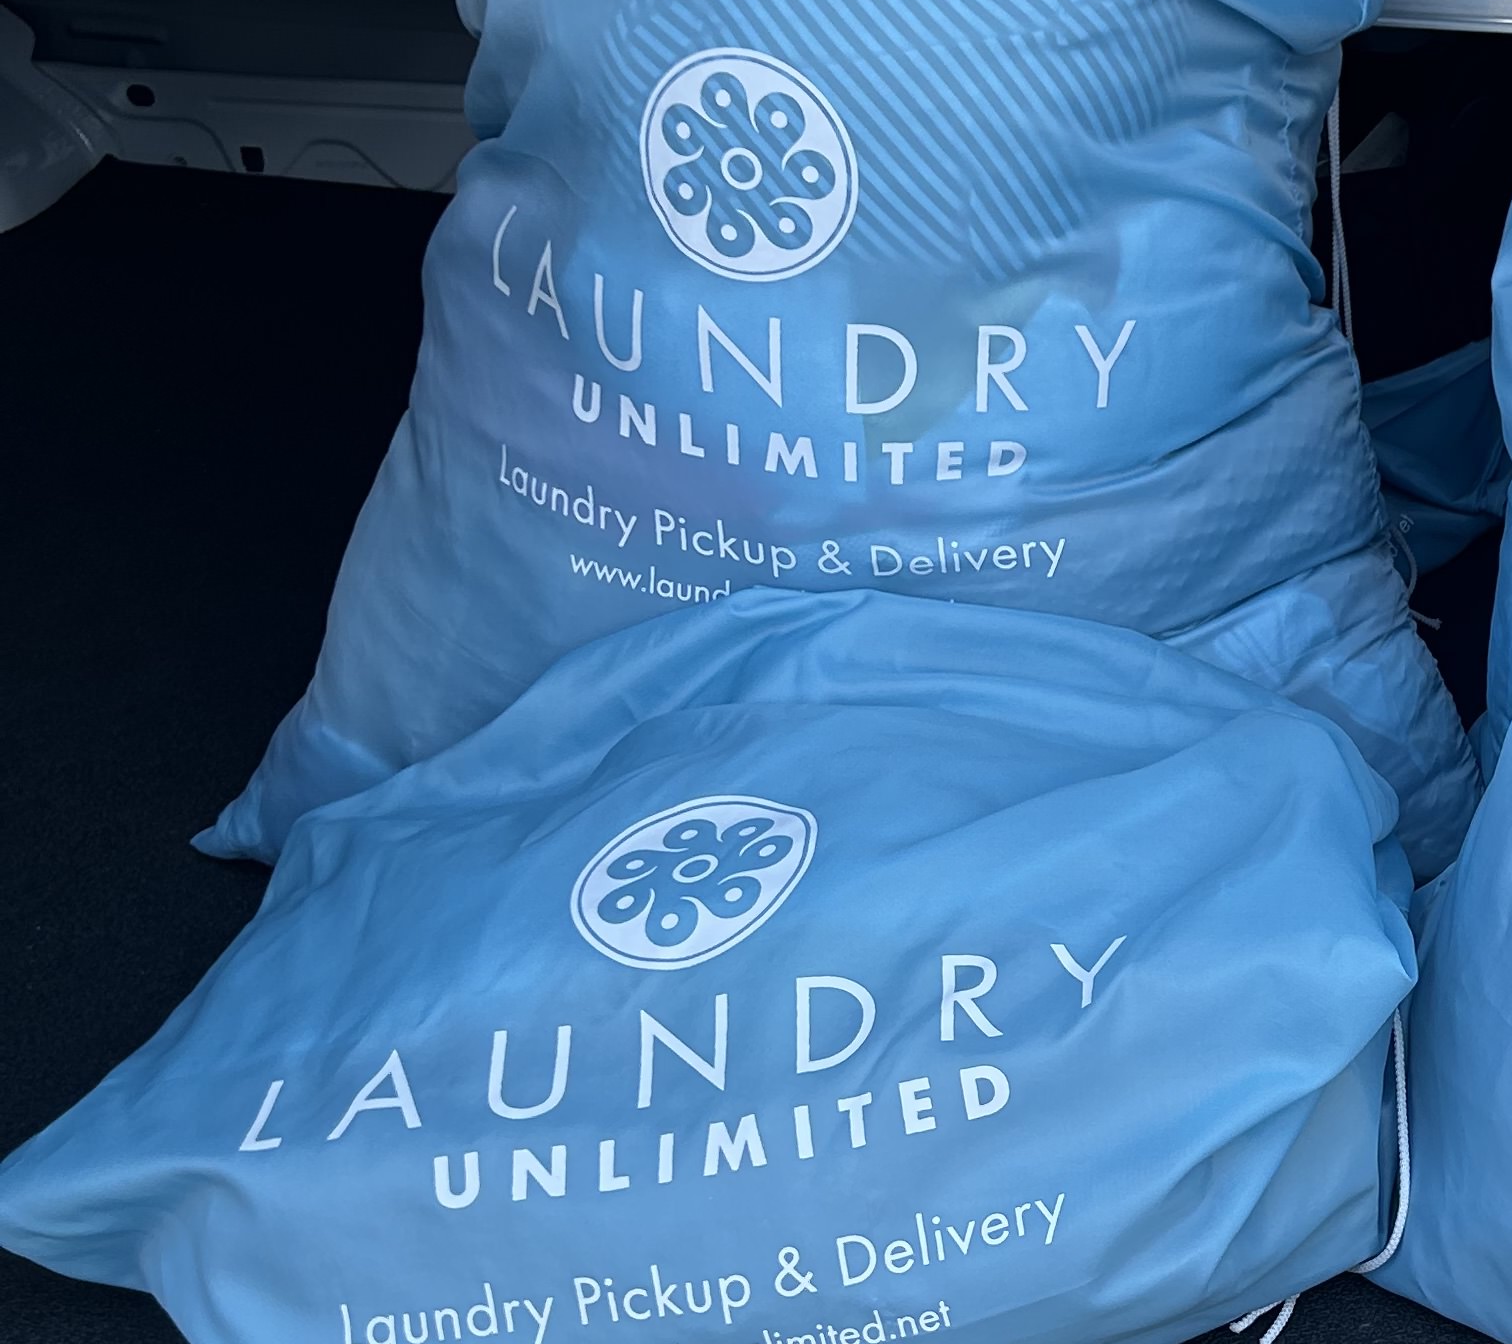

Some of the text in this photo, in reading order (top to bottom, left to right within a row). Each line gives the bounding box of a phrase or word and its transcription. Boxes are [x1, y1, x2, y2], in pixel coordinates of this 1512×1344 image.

[493, 204, 1136, 415] LAUNDRY
[574, 376, 1028, 485] UNLIMITED
[500, 446, 1065, 578] Laundry Pickup & Delivery
[239, 935, 1126, 1152] LAUNDRY
[434, 1065, 1010, 1209] UNLIMITED
[576, 1264, 751, 1327] Pickup
[775, 1247, 815, 1297] &
[838, 1193, 1064, 1286] Delivery
